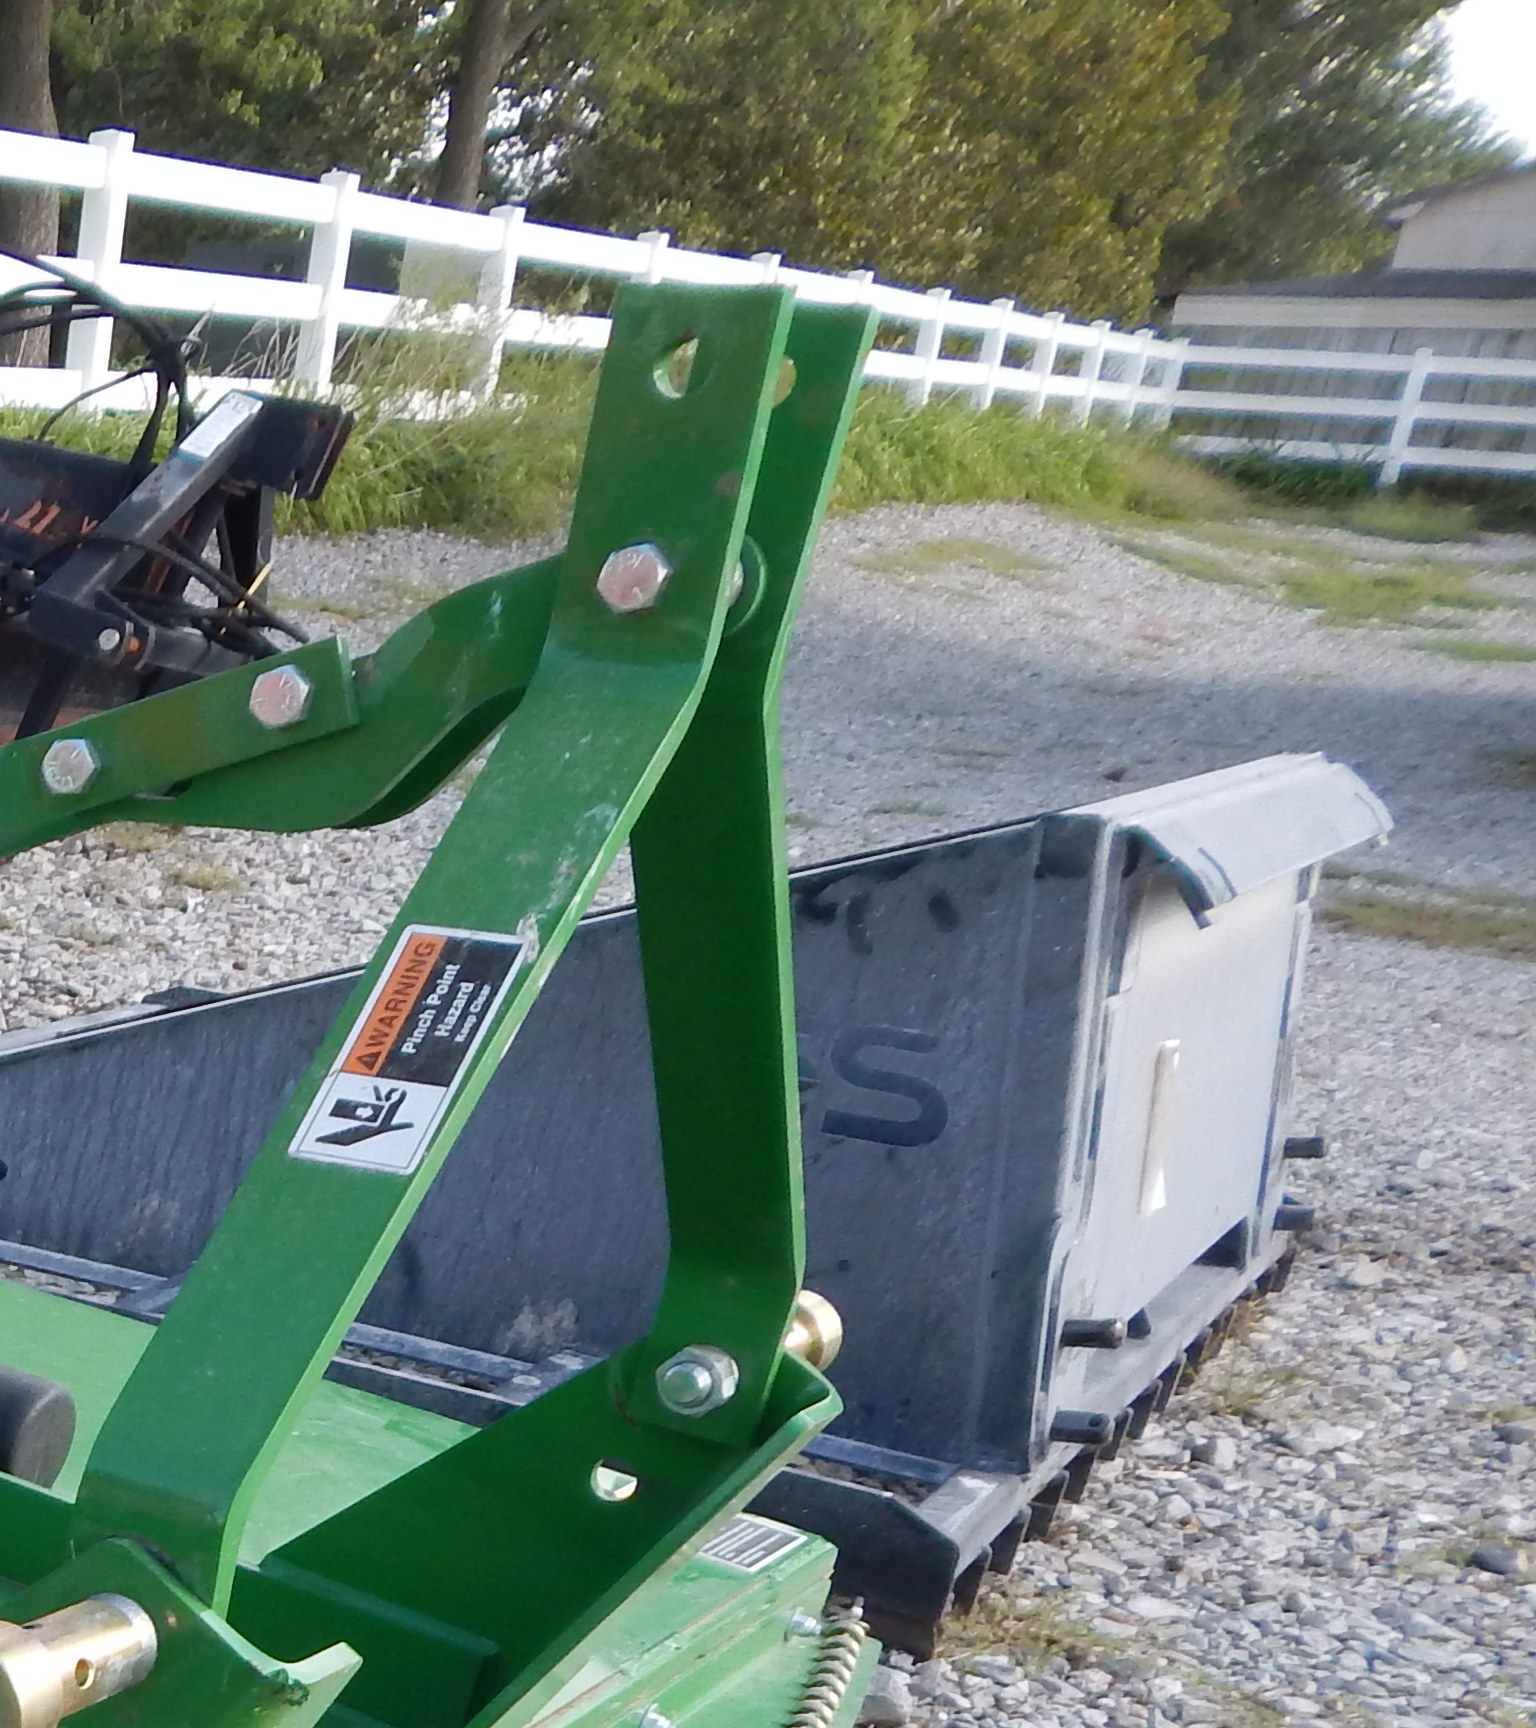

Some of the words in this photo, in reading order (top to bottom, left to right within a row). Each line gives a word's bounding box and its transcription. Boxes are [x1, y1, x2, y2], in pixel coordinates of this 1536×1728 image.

[368, 941, 436, 1050] WARNING
[400, 1009, 437, 1054] Pinch
[426, 964, 461, 1006] Point
[434, 981, 475, 1037] Hazard
[454, 1014, 478, 1042] Keep
